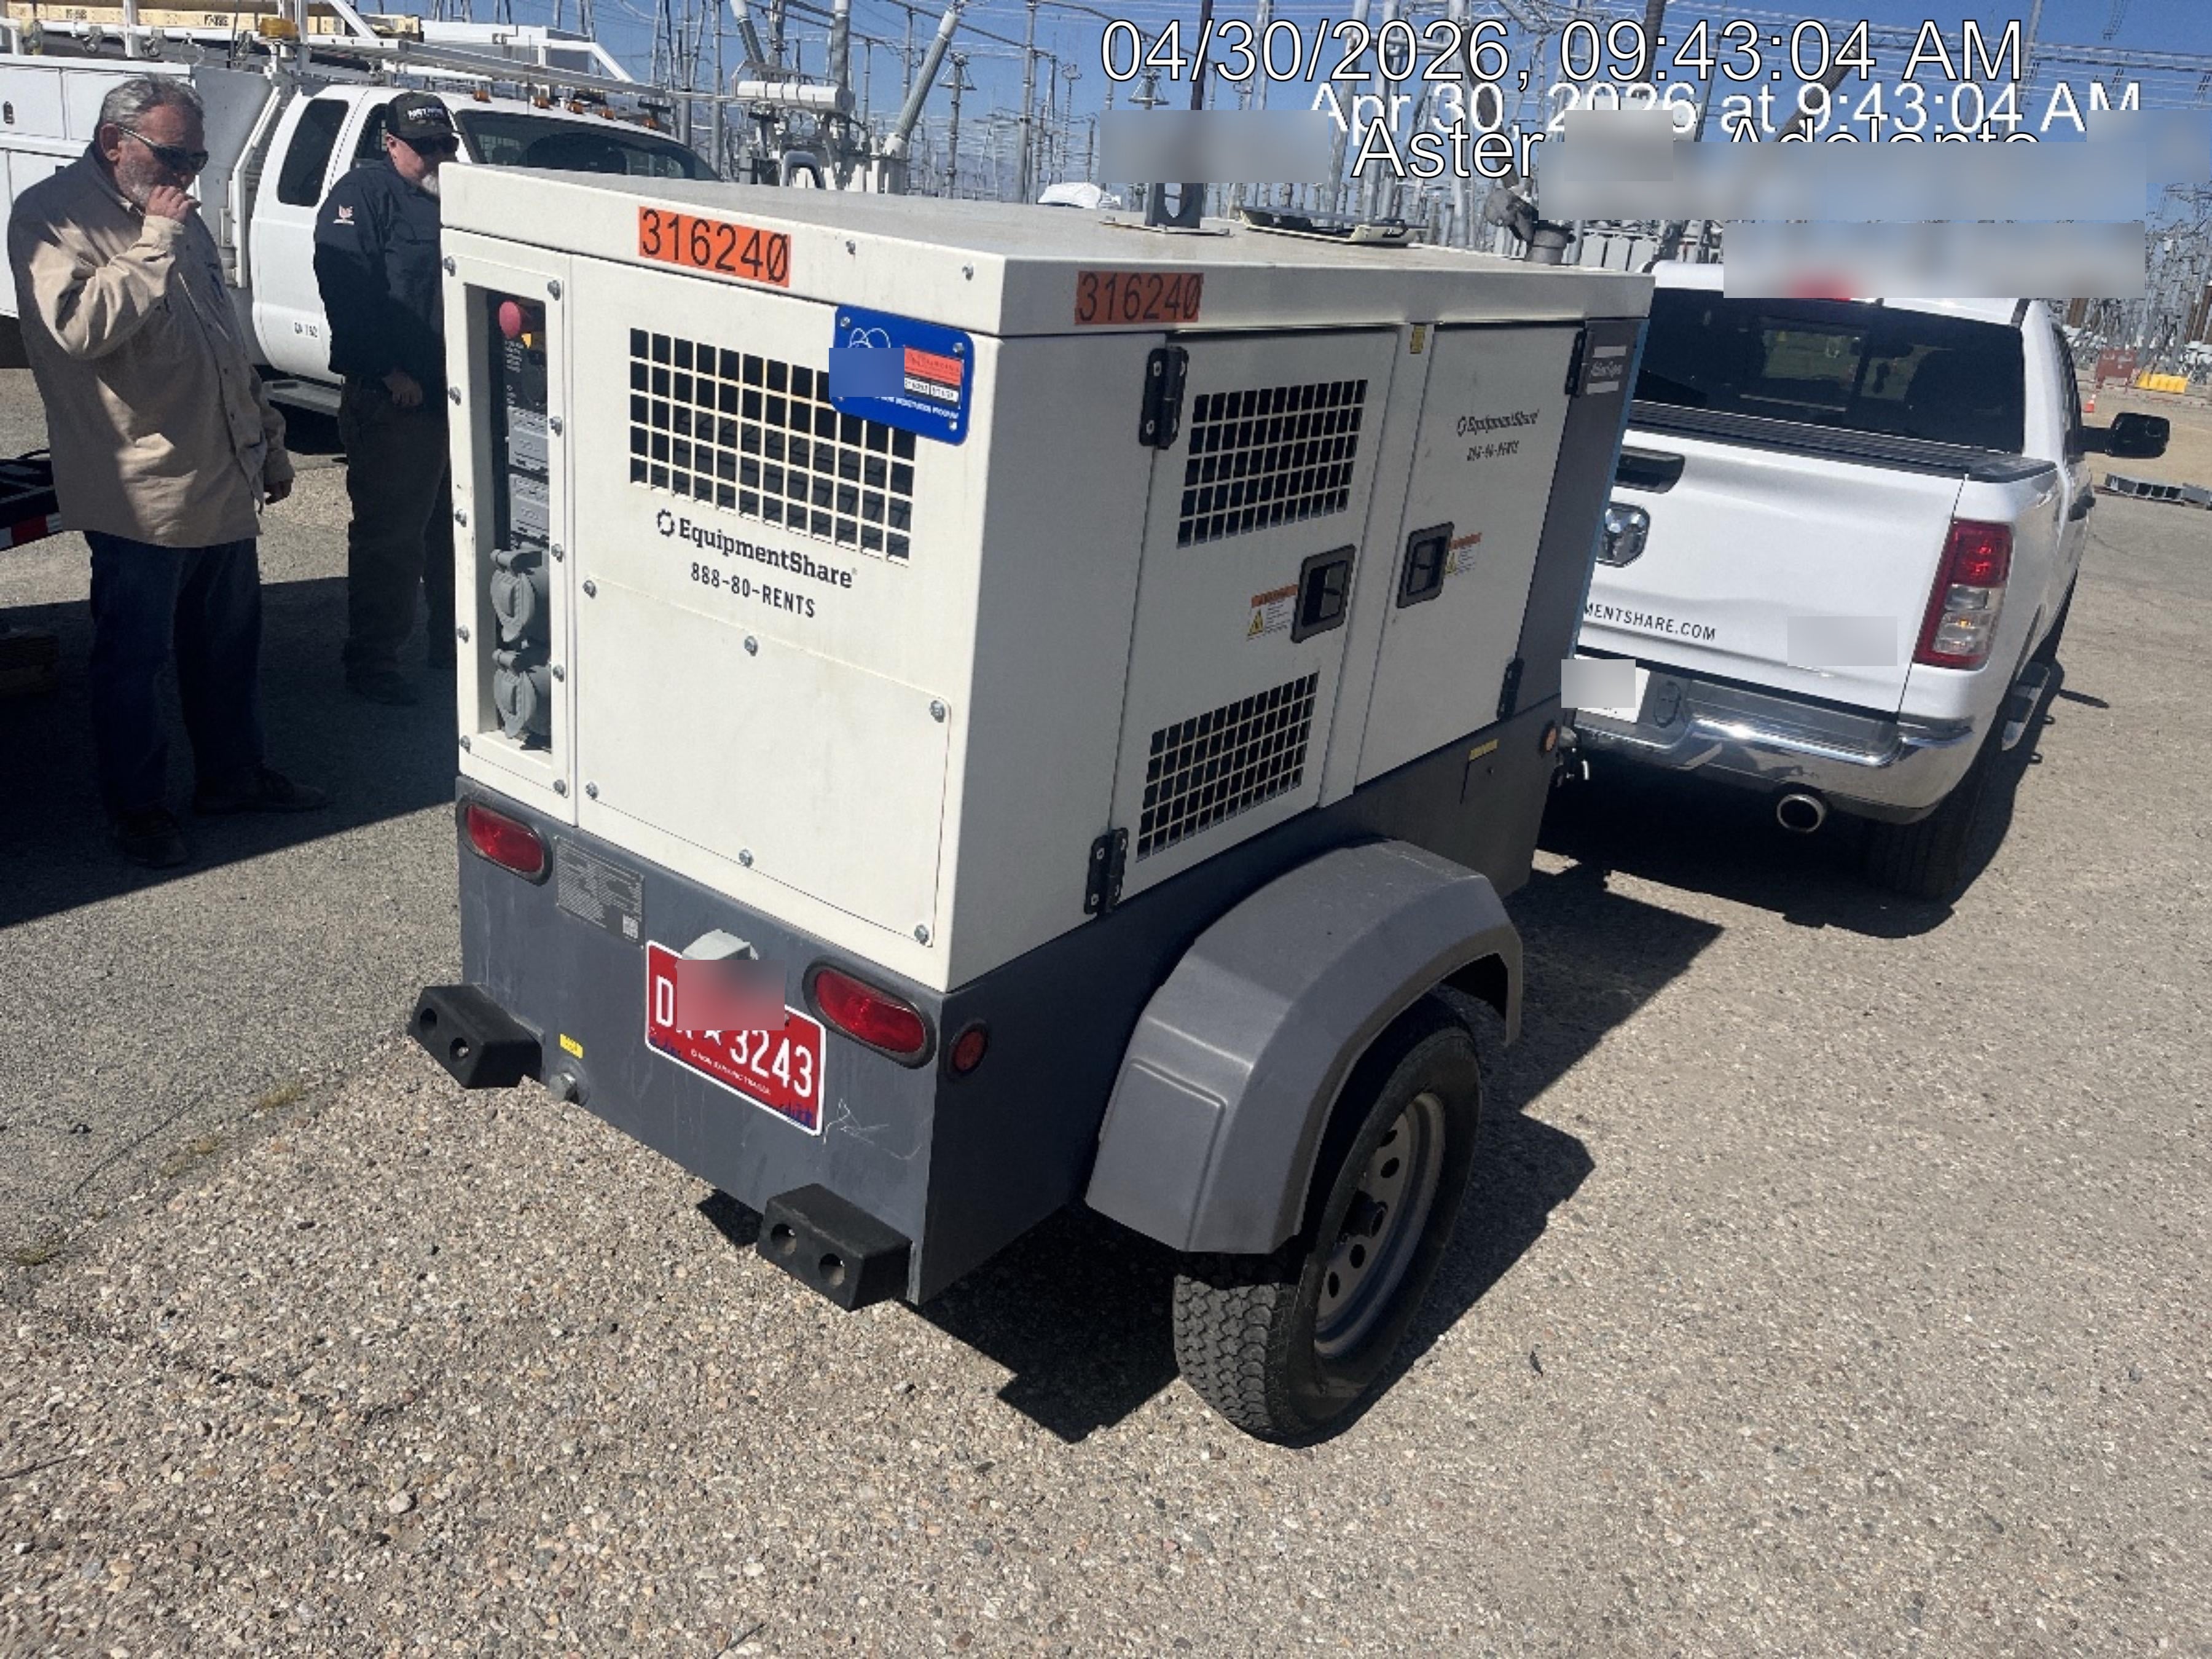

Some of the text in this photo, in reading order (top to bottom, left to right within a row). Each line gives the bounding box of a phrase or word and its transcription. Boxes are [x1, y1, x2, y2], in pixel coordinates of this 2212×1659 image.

[642, 208, 788, 283] 316240
[1079, 272, 1204, 321] 316240
[679, 517, 853, 588] EquipmentShare
[691, 561, 815, 618] 888-80-RENTS
